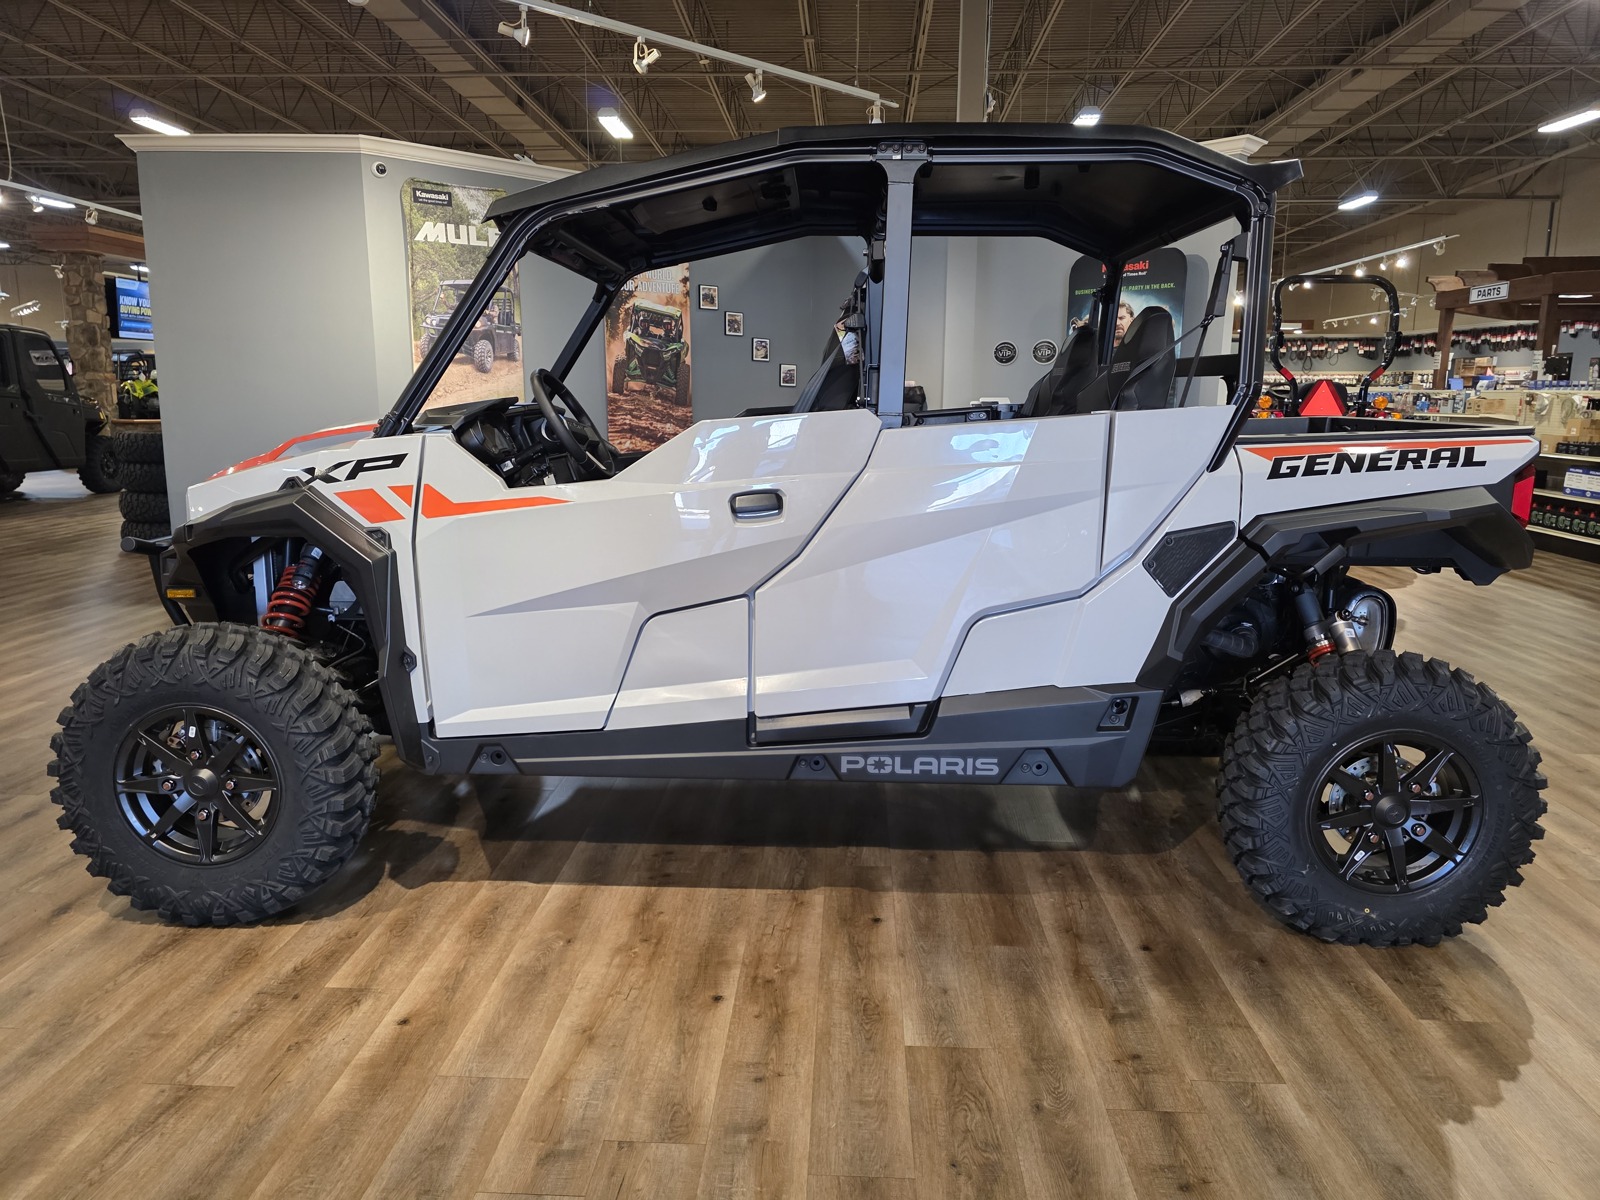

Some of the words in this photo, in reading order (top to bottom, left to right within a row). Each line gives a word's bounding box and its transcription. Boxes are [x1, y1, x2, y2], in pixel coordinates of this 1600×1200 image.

[416, 190, 449, 200] Kawasaki
[637, 281, 680, 295] ADVENTURE
[1477, 287, 1501, 299] PARTS
[119, 295, 138, 306] KNOW
[120, 304, 141, 315] BUYING
[299, 452, 409, 487] XP
[1266, 446, 1488, 480] GENERAL
[840, 756, 999, 776] POLARIS
